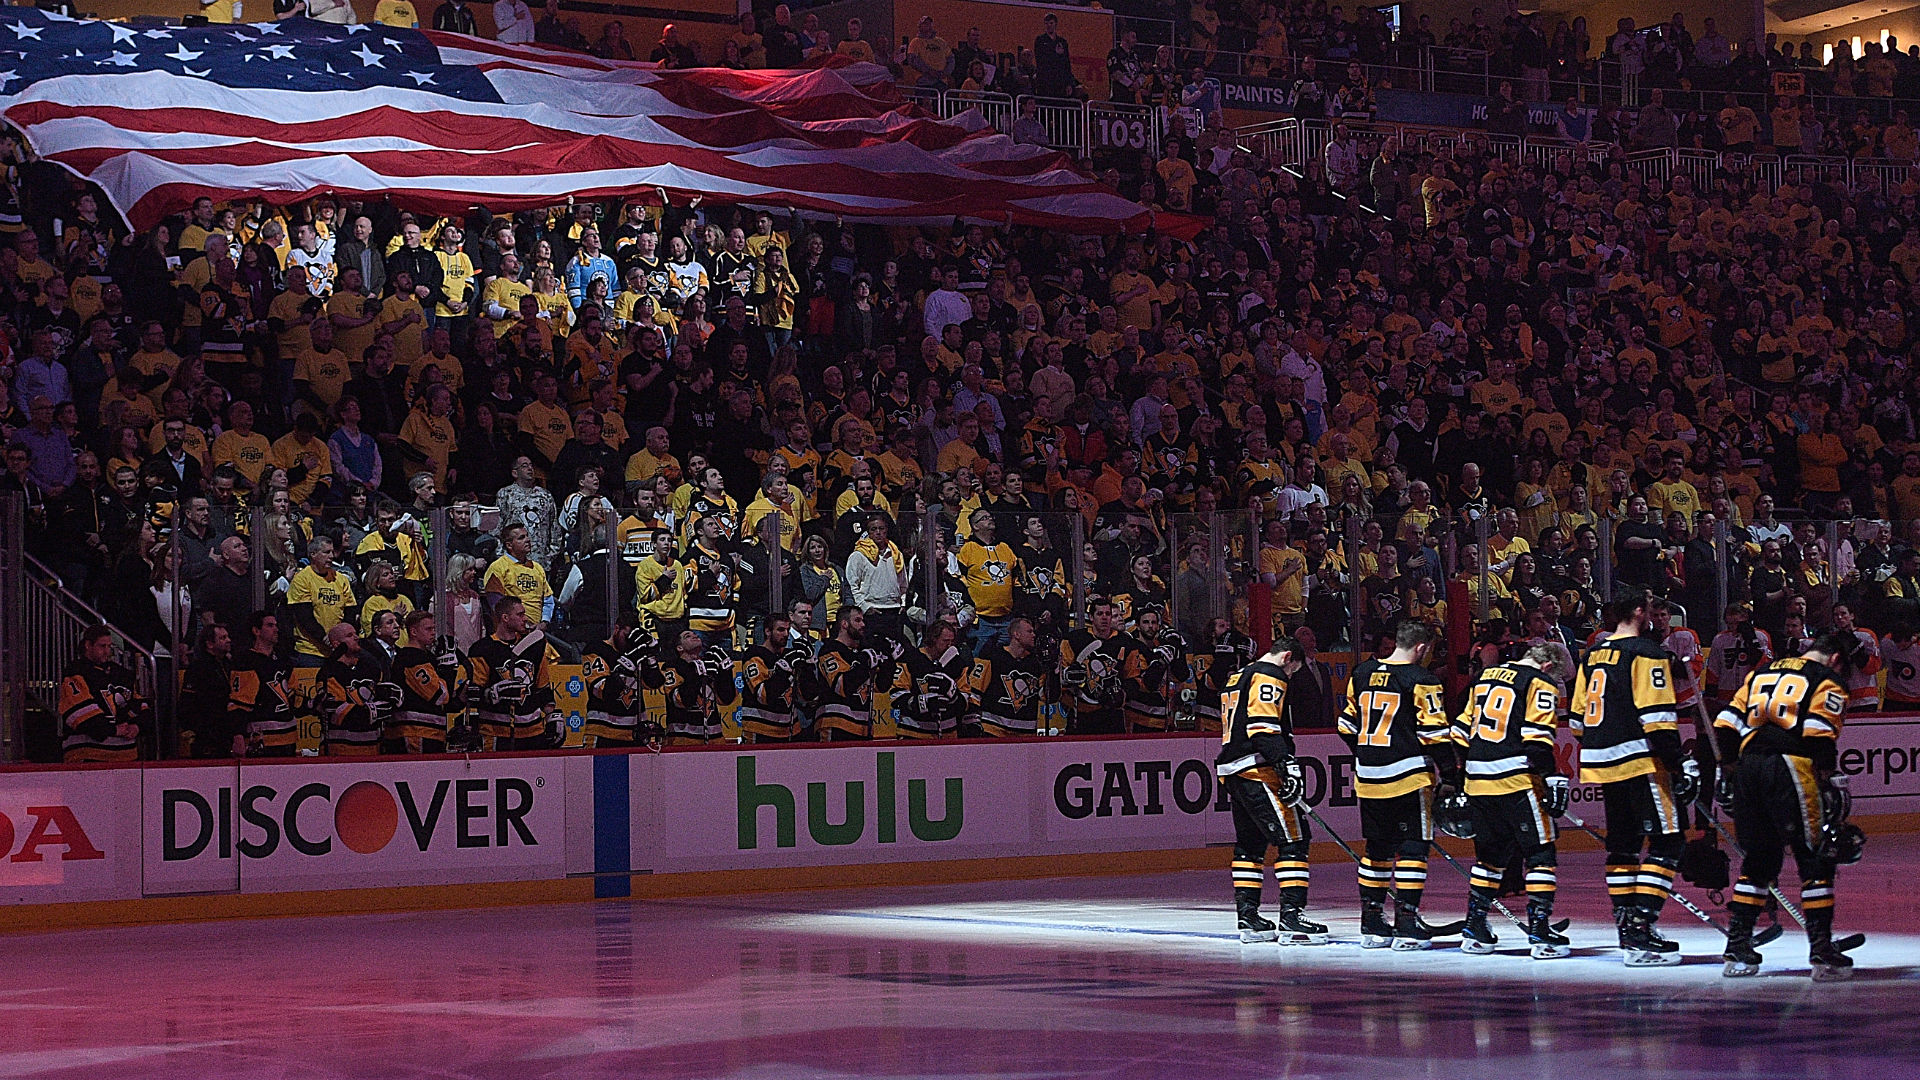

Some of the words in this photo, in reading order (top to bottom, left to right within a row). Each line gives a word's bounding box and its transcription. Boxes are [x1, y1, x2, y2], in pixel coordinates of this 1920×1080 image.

[1225, 84, 1284, 106] PAINTS
[1099, 119, 1145, 148] 103
[852, 521, 862, 534] C
[318, 591, 341, 603] PENS!
[415, 668, 430, 684] 3
[973, 663, 985, 679] 2
[1651, 667, 1666, 689] 8
[69, 682, 80, 696] 1
[1259, 683, 1285, 706] 87
[1584, 668, 1607, 727] 8
[1747, 673, 1809, 730] 58
[1357, 690, 1402, 747] 17
[1471, 683, 1516, 744] 59
[737, 751, 964, 850] hulu
[163, 777, 538, 861] DISCOVER
[1673, 892, 1711, 923] CCM
